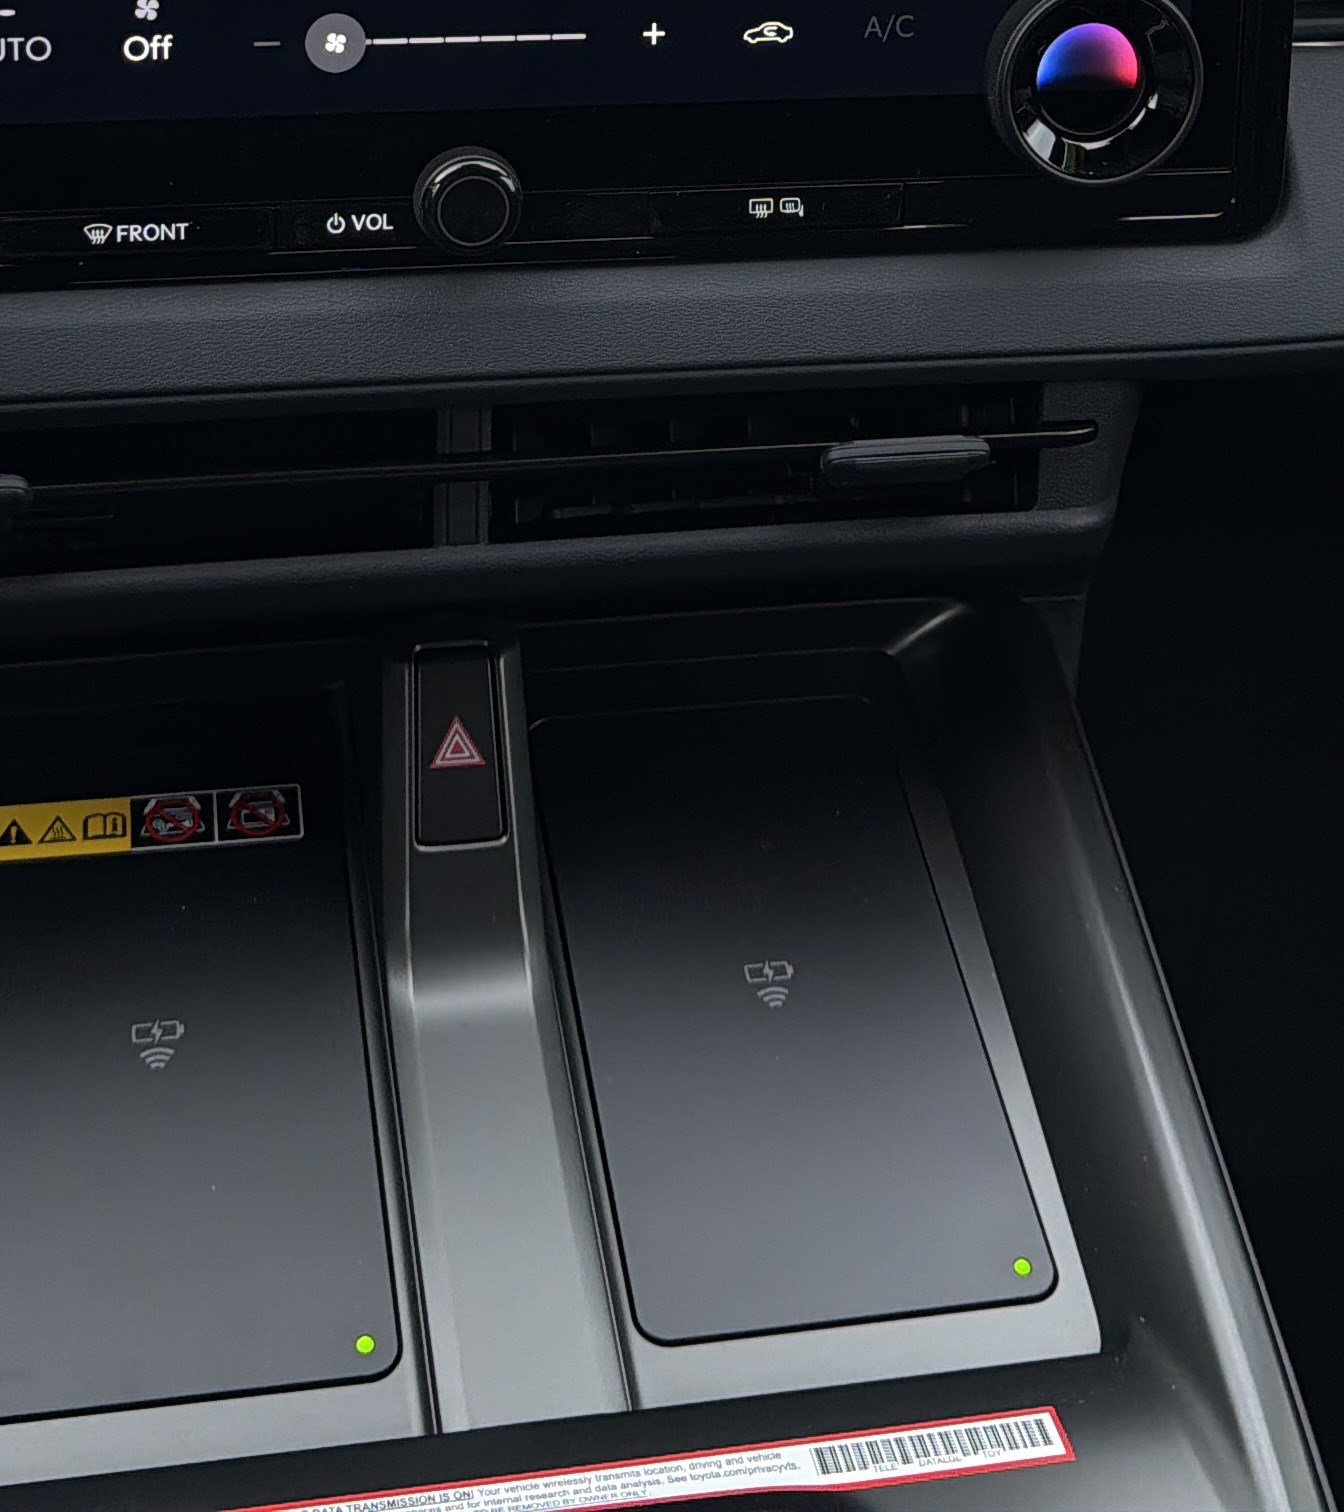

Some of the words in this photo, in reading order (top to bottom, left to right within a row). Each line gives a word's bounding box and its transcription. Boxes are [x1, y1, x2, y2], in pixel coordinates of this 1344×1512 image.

[863, 13, 915, 40] A/C
[123, 33, 173, 62] Off
[116, 221, 190, 243] FRONT
[350, 212, 394, 232] VOL
[873, 1462, 899, 1473] TELE
[982, 1449, 1002, 1459] TOY
[439, 1492, 451, 1502] IS
[477, 1486, 501, 1497] Your
[504, 1482, 540, 1494] vehicle
[543, 1475, 592, 1489] wirelessly
[595, 1469, 641, 1482] transmits
[644, 1464, 686, 1477] location,
[688, 1459, 722, 1471] driving
[725, 1456, 744, 1466] and
[747, 1451, 782, 1463] vehicle
[444, 1502, 464, 1512] and
[467, 1500, 481, 1509] for
[484, 1495, 522, 1507] internal
[525, 1488, 570, 1501] research
[572, 1486, 592, 1496] and
[595, 1483, 618, 1493] data
[620, 1478, 665, 1490] analysis.
[667, 1474, 688, 1484] See
[562, 1497, 576, 1506] BY
[578, 1492, 619, 1503] OWNER
